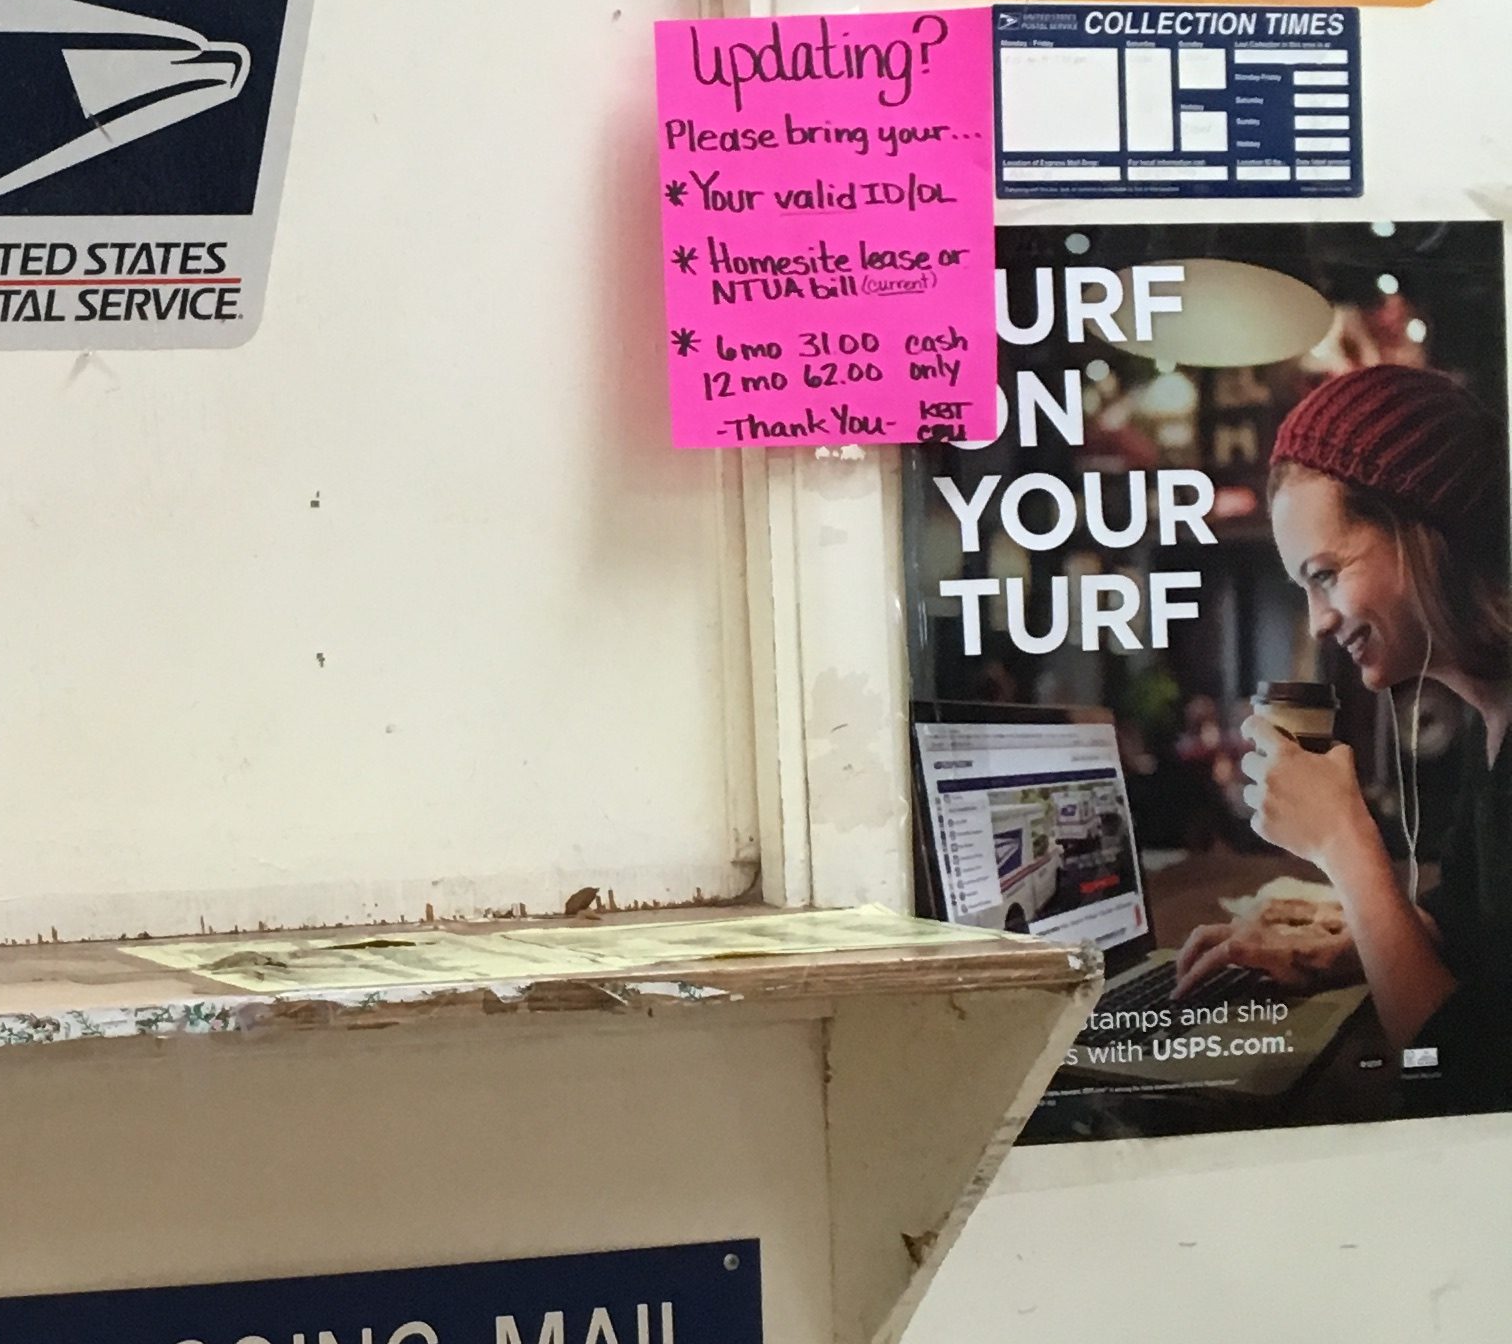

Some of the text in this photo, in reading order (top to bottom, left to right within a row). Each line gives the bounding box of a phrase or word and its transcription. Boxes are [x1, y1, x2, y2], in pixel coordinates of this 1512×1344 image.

[1084, 11, 1260, 36] COLLECTION
[1265, 12, 1345, 36] TIMES
[690, 15, 949, 112] Updating?
[665, 118, 779, 153] Please
[785, 113, 868, 154] bring
[774, 179, 857, 212] valid
[863, 173, 958, 212] ID/DL
[84, 241, 228, 275] STATES
[706, 236, 970, 276] Homesite lease or
[712, 270, 938, 305] NTUA bill (current)
[994, 264, 1186, 346] URF
[904, 325, 969, 355] cash
[703, 354, 961, 401] 12 mo 62.00 only
[932, 468, 1219, 553] YOUR
[939, 571, 1202, 656] TURF
[1180, 1000, 1229, 1025] and
[1237, 999, 1289, 1023] ship
[1087, 1040, 1143, 1064] with
